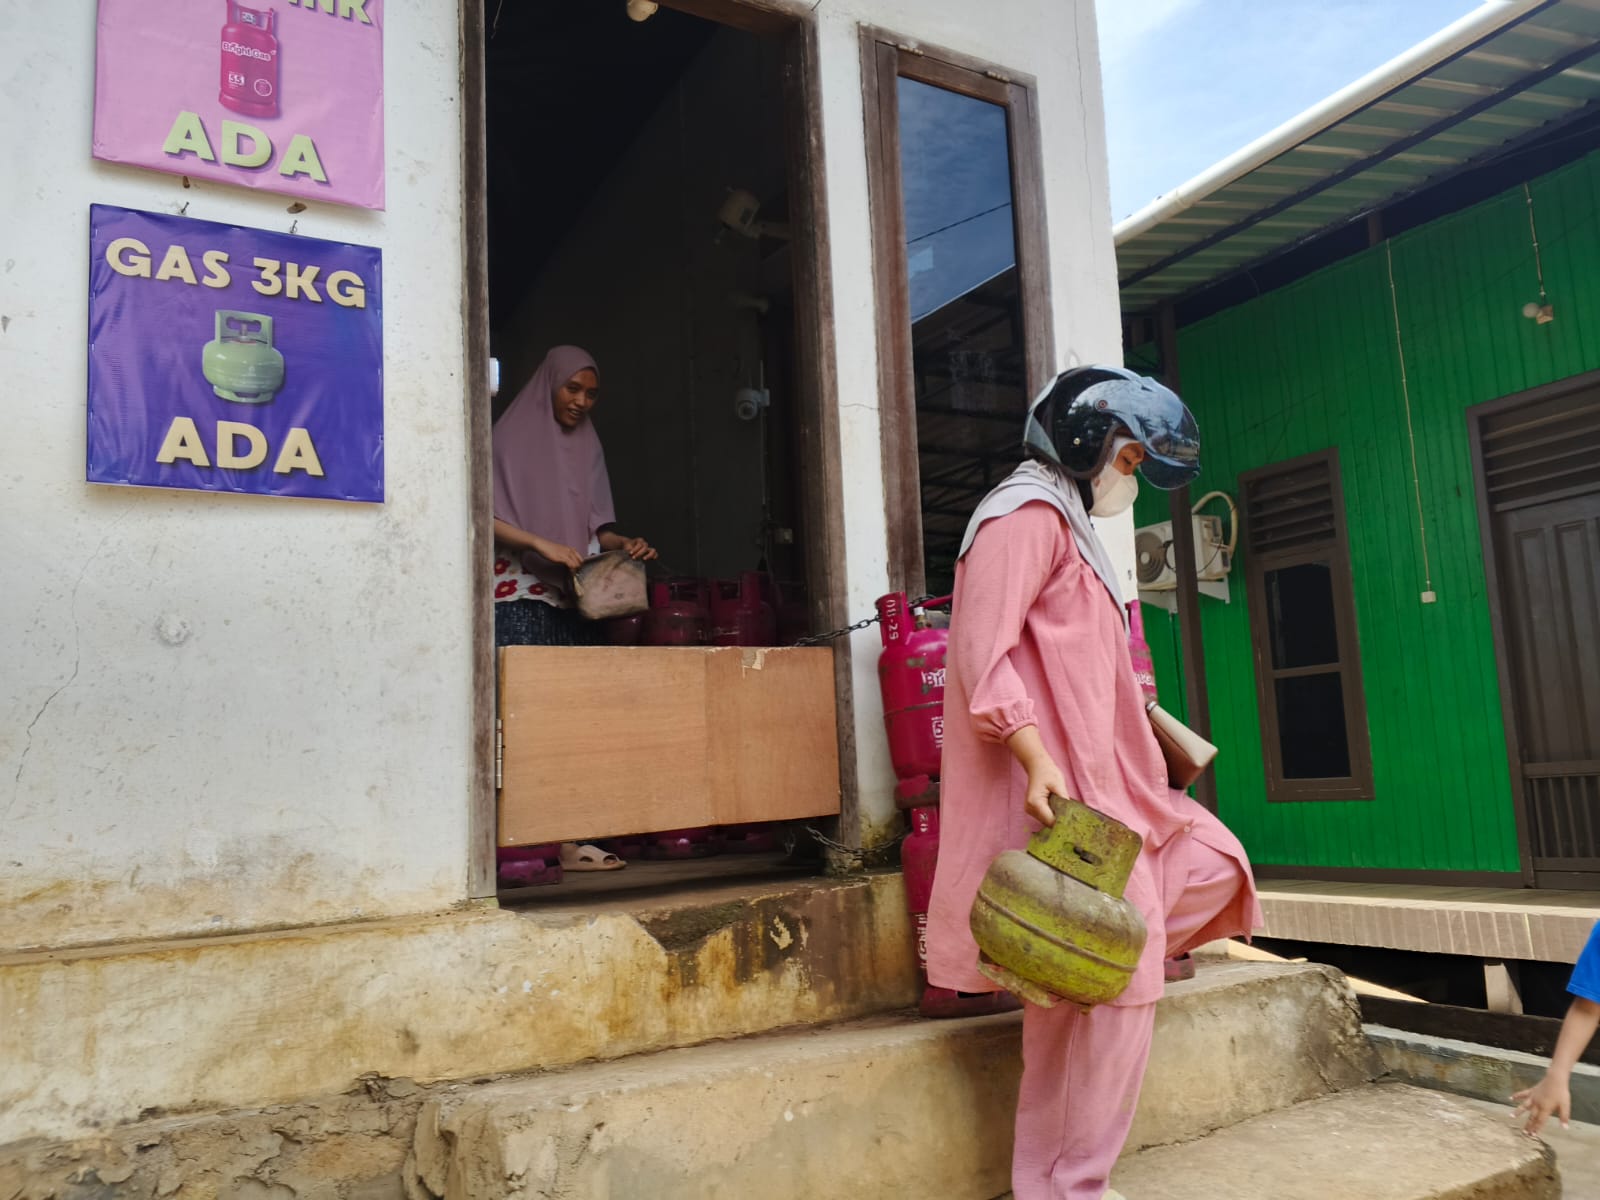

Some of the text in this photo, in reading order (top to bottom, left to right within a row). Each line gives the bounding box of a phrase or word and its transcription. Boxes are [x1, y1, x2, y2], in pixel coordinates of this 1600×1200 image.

[162, 111, 328, 182] ADA
[105, 237, 366, 308] GAS 3KG
[156, 416, 324, 476] ADA
